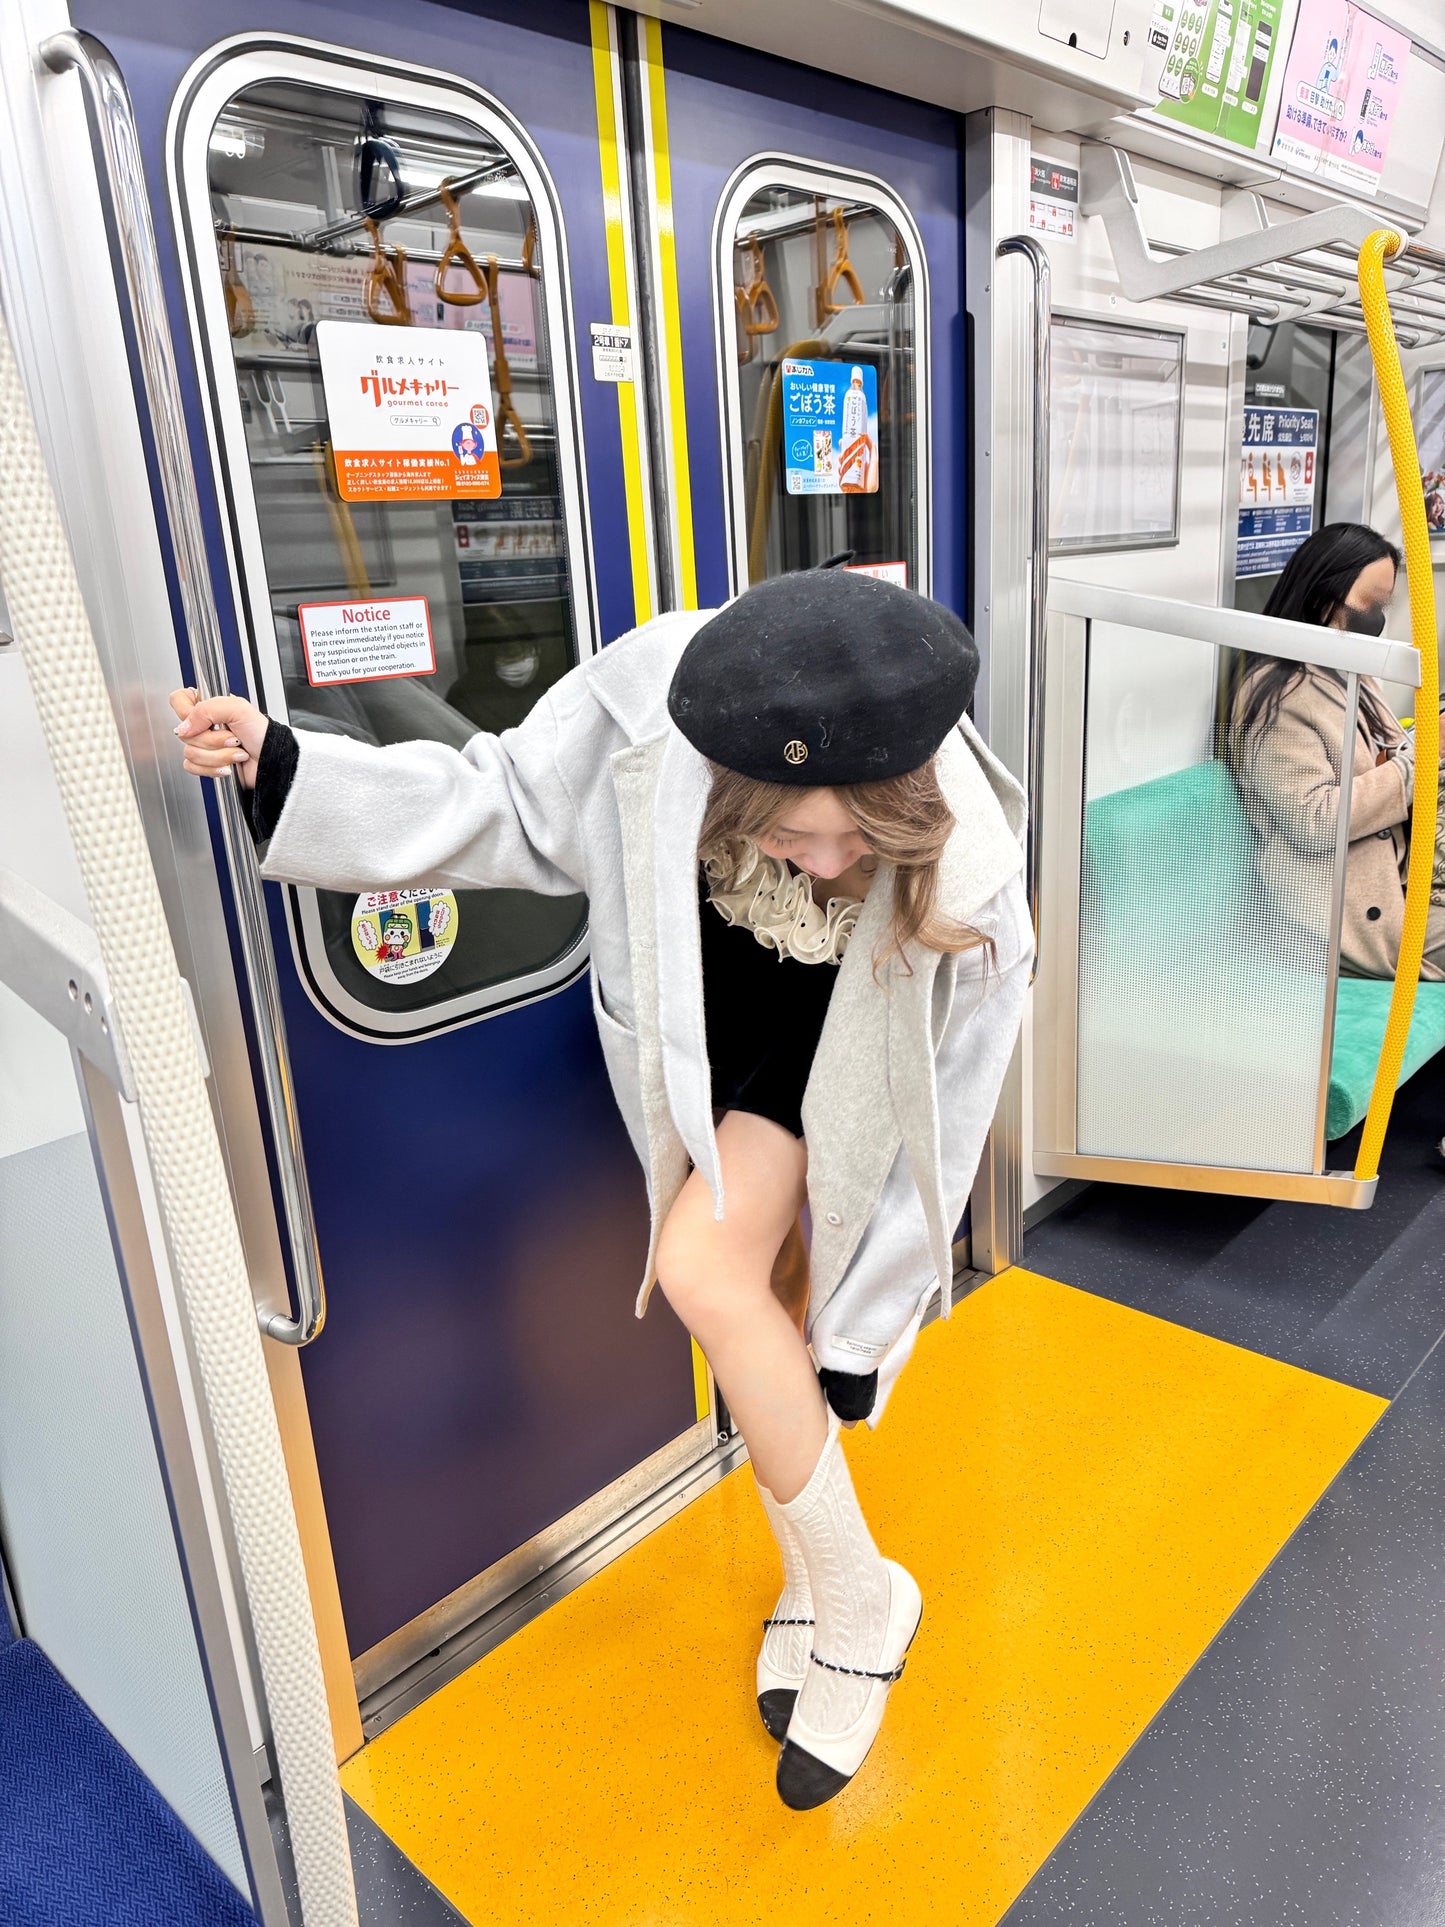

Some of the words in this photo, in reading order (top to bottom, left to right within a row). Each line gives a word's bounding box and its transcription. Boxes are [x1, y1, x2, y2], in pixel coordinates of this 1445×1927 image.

[375, 355, 444, 366] 飲食求人サイト
[360, 369, 460, 408] グルメキャリー
[789, 392, 836, 415] ごぼう茶
[1278, 414, 1300, 432] Priority
[1300, 416, 1314, 430] Seat
[342, 606, 391, 623] Notice
[310, 629, 333, 638] Please
[335, 627, 359, 636] inform
[361, 625, 373, 633] the
[374, 623, 398, 633] station
[399, 622, 414, 630] staff
[312, 639, 328, 648] train
[329, 637, 346, 646] crew
[346, 634, 386, 645] immediately
[387, 633, 392, 641] if
[393, 633, 405, 642] you
[406, 631, 425, 639] notice
[313, 650, 326, 658] any
[327, 647, 361, 657] suspicious
[362, 644, 395, 653] unclaimed
[396, 640, 419, 650] objects
[419, 640, 426, 648] in
[315, 659, 327, 667] the
[327, 656, 350, 666] station
[368, 654, 379, 662] the
[380, 652, 397, 661] train.
[316, 669, 338, 678] Thank
[338, 668, 351, 677] you
[352, 667, 362, 675] for
[362, 666, 377, 675] your
[377, 662, 416, 672] cooperation.
[413, 895, 431, 904] opening
